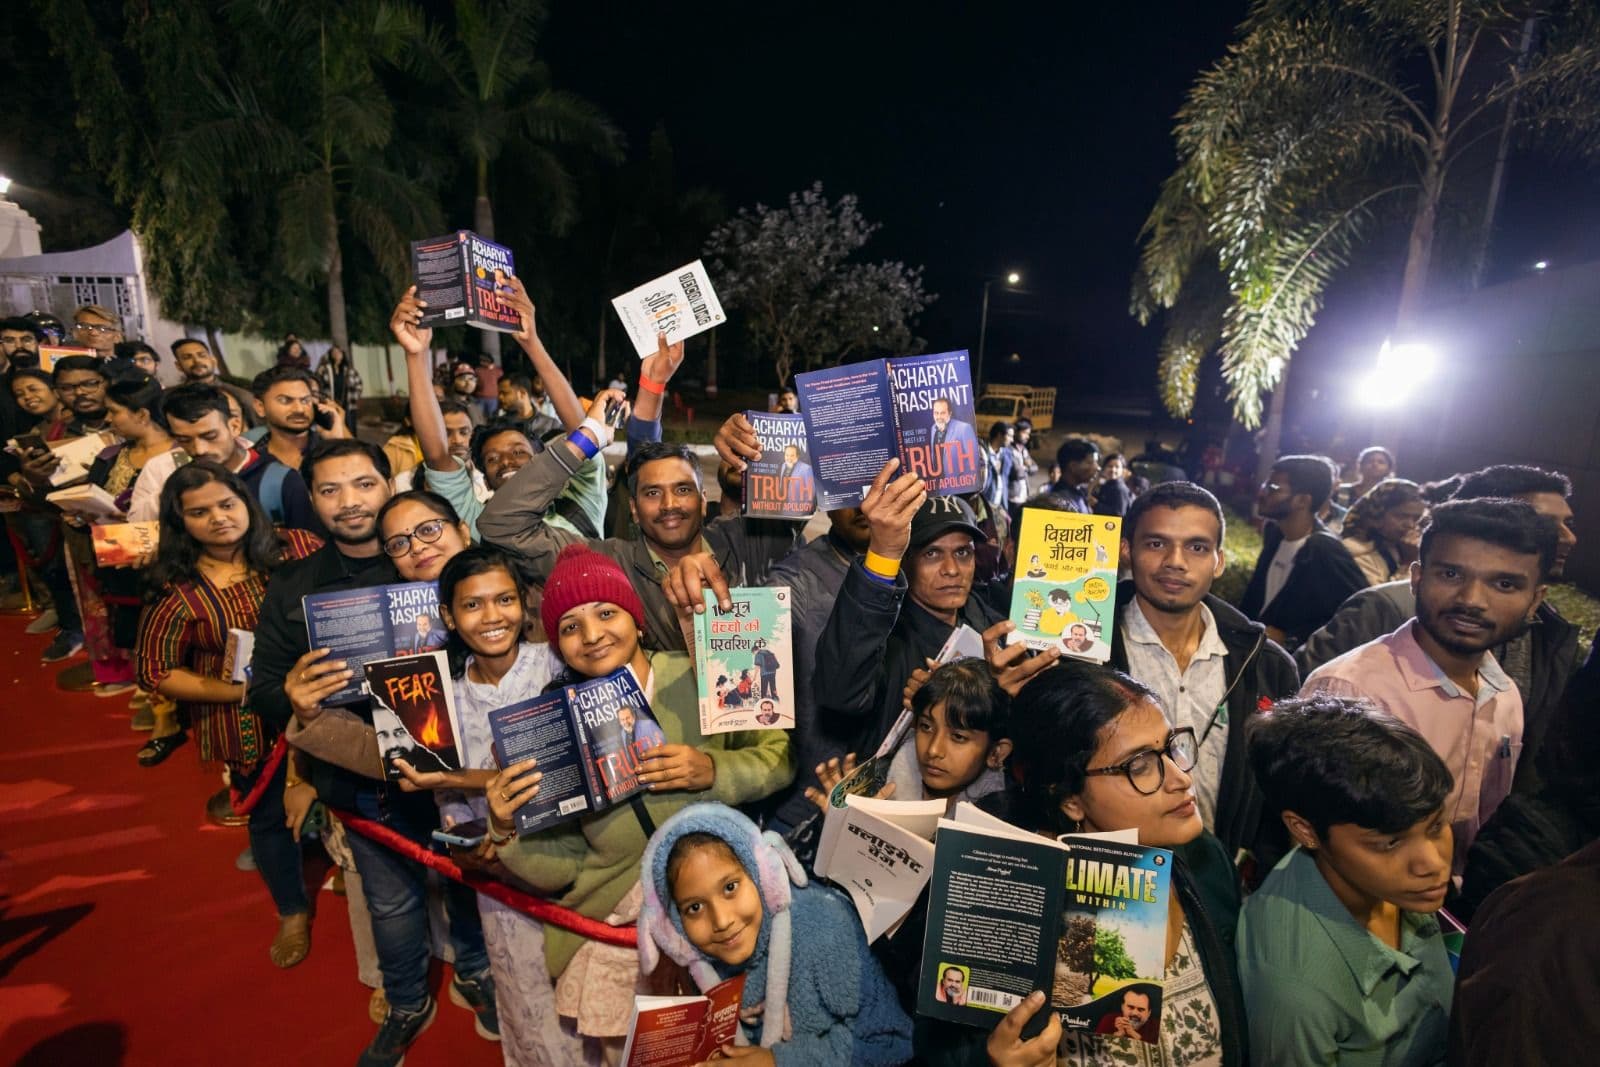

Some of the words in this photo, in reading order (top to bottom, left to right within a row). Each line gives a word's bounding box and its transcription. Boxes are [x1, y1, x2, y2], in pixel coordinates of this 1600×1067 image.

[472, 240, 508, 264] ACHARYA
[472, 253, 512, 277] PRASHANT
[476, 287, 519, 316] TRU
[480, 308, 498, 320] WITHOUT
[644, 291, 677, 335] SUCCESS
[892, 362, 958, 390] ACHARYA
[752, 418, 807, 436] ACHARYA
[754, 436, 807, 453] RASHAN
[906, 440, 976, 478] RUTH
[750, 475, 813, 501] TRUTH
[939, 474, 976, 490] APOLOGY
[752, 501, 781, 511] WITHOUT
[783, 502, 813, 512] APOLOGY
[1044, 523, 1094, 543] विद्यार्थी
[1050, 542, 1088, 561] जीवन
[728, 601, 750, 617] सूत्र
[744, 618, 760, 632] की
[710, 634, 750, 651] परवरिश
[753, 636, 767, 649] के
[384, 672, 441, 709] FEAR
[578, 676, 632, 710] CHARYA
[584, 690, 645, 729] RASHANT
[606, 778, 638, 800] WITHOUT
[1093, 847, 1122, 855] BESTSELLING
[1066, 858, 1158, 903] LIMATE
[1076, 894, 1127, 910] WITHIN
